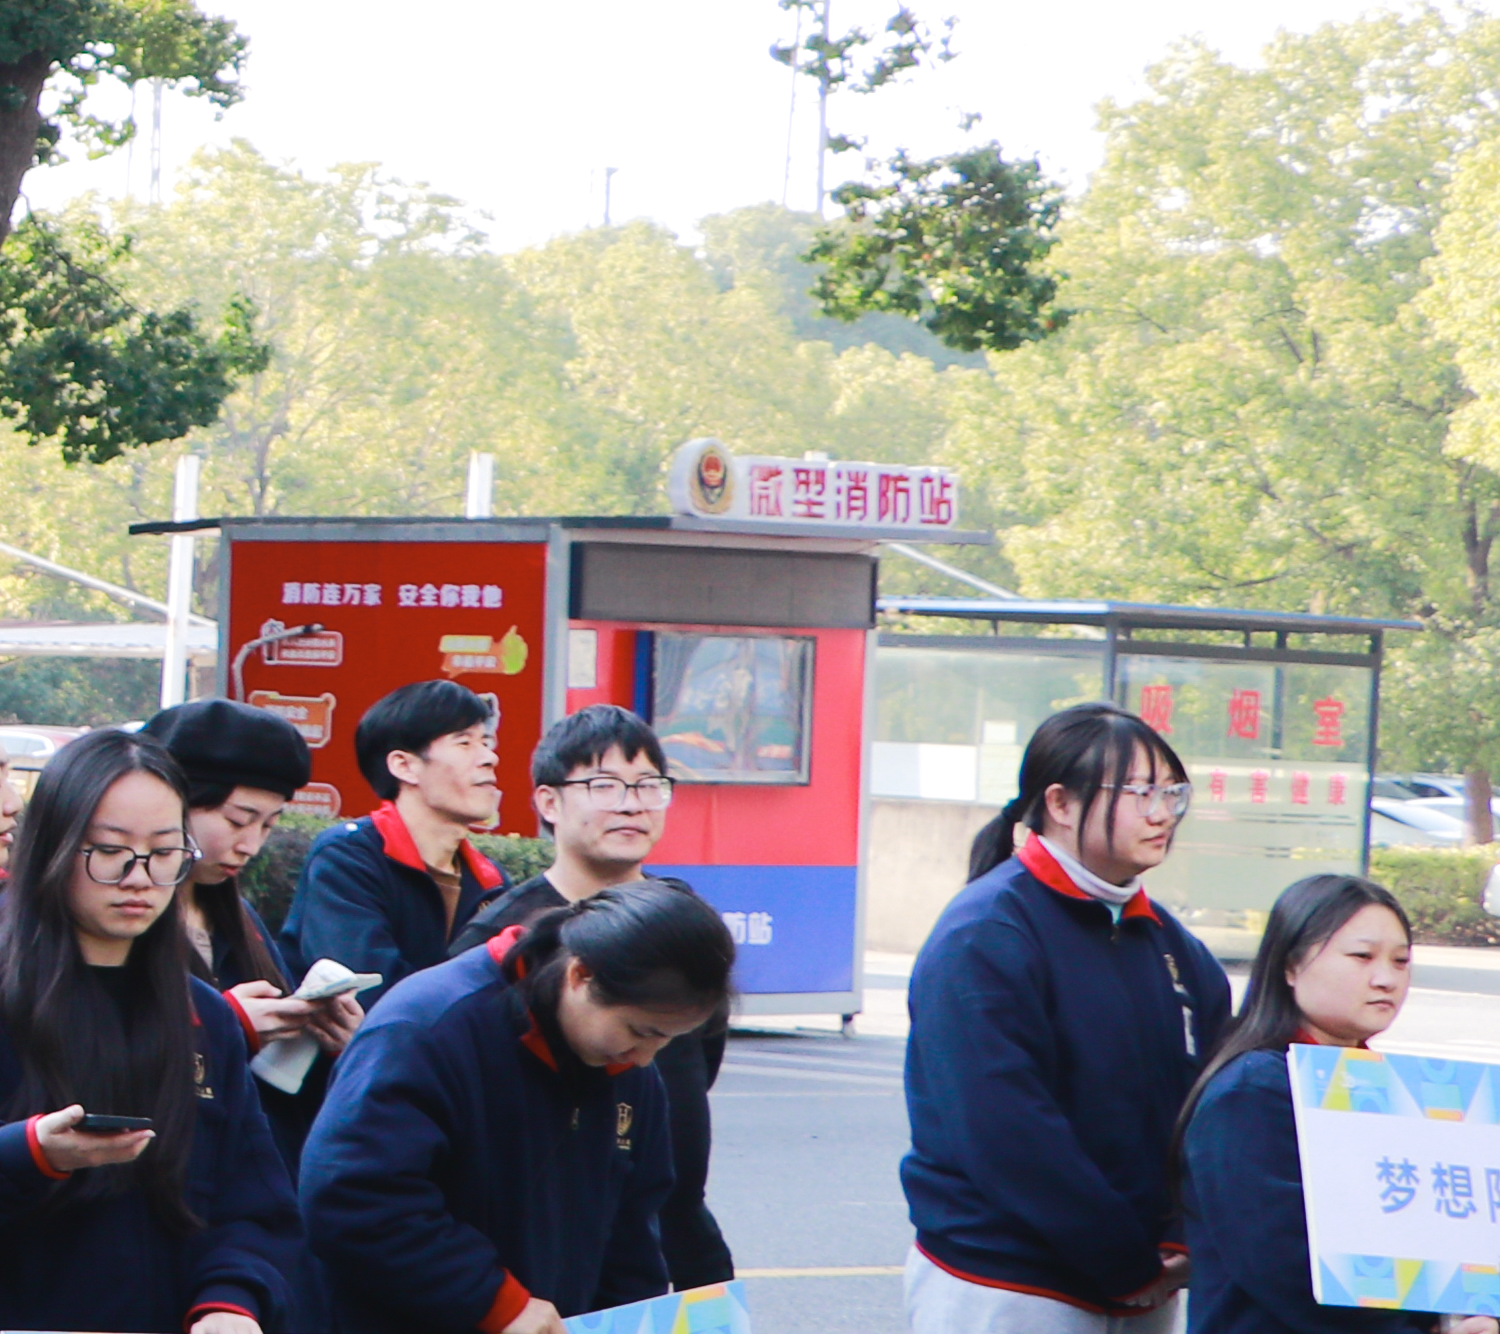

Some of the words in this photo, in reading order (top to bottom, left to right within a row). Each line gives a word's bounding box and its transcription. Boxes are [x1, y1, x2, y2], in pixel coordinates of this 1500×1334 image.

[750, 464, 953, 525] 微型消防站
[1141, 684, 1345, 746] 吸烟室
